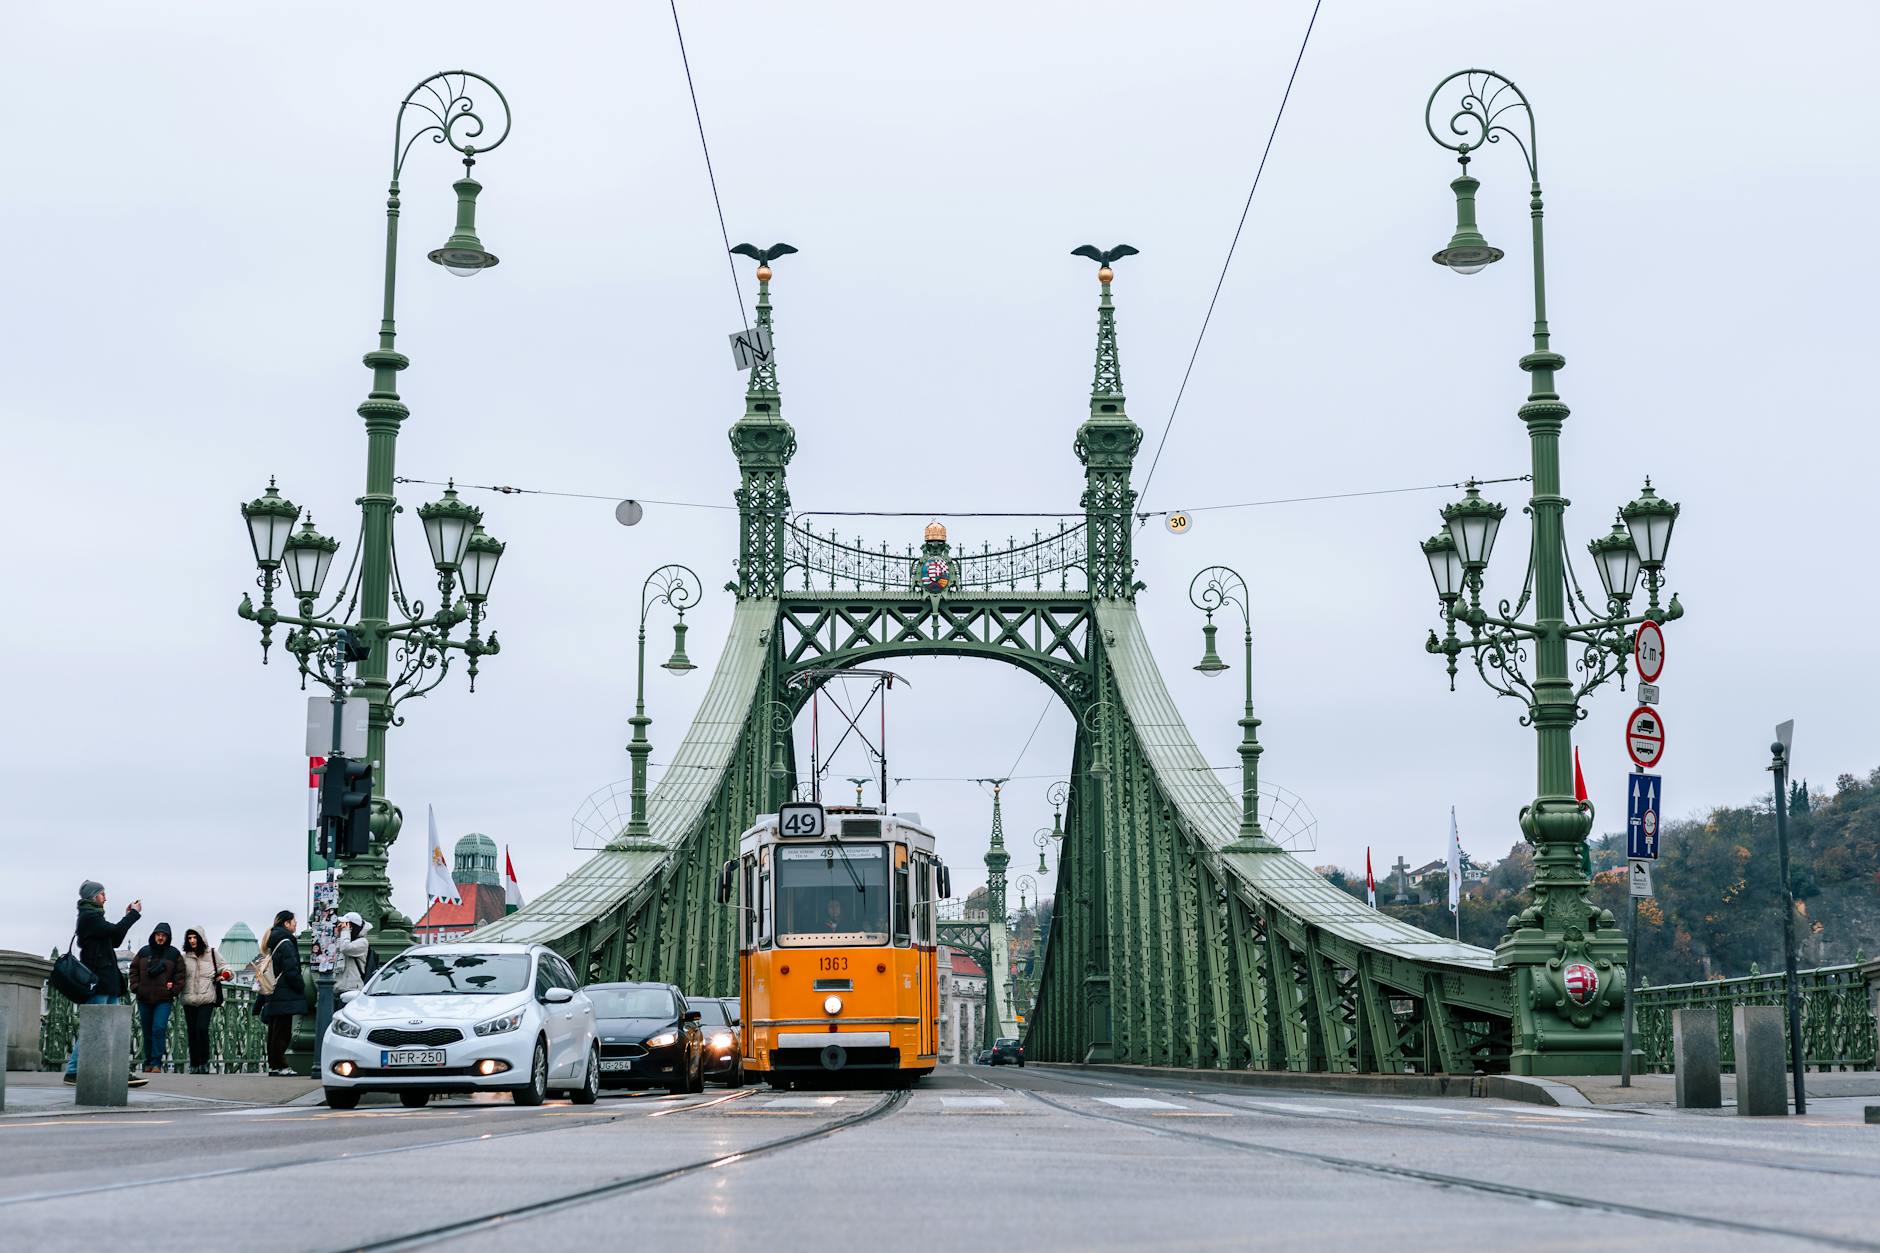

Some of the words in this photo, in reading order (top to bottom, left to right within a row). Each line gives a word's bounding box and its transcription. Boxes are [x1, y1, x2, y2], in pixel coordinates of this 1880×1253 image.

[1171, 517, 1186, 528] 30
[1642, 641, 1647, 660] 2
[1649, 648, 1656, 661] m
[785, 814, 816, 834] 49
[821, 849, 834, 858] 49
[820, 957, 848, 971] 1363
[390, 1052, 442, 1063] NFR-250
